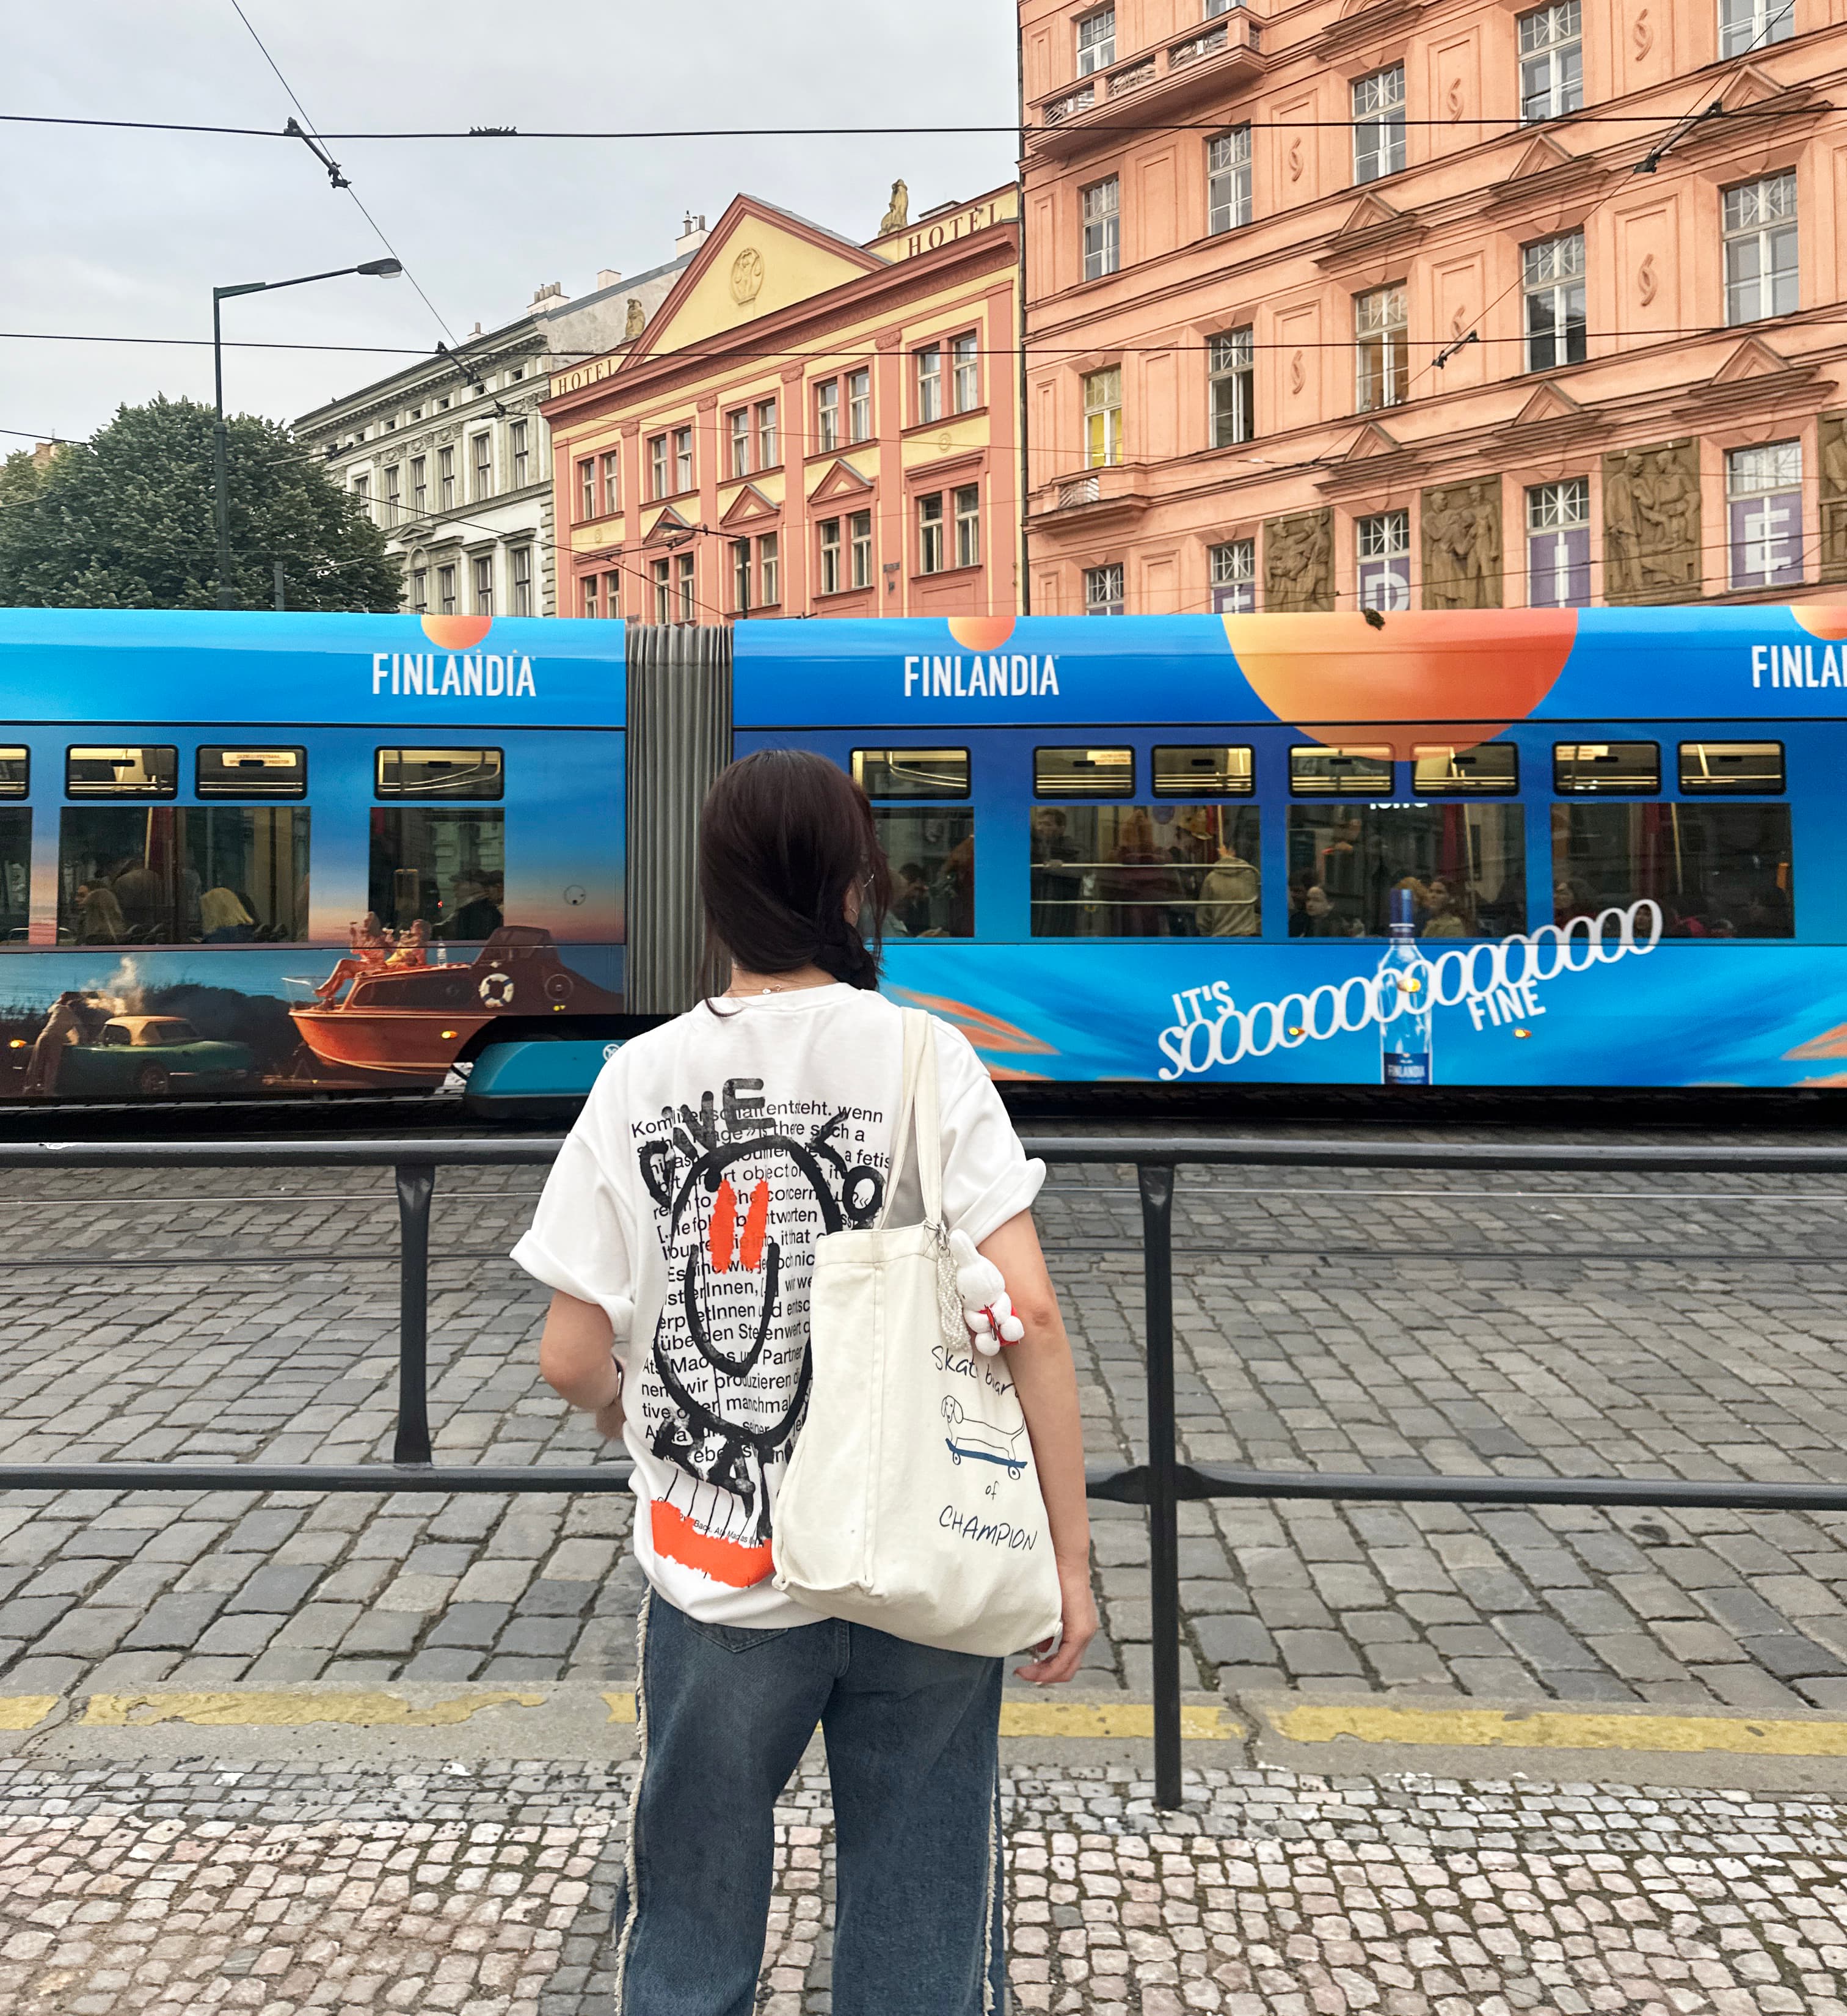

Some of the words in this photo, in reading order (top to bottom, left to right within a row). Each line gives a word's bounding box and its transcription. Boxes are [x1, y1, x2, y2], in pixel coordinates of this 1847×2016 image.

[908, 202, 1002, 257] HOTEL
[1744, 508, 1791, 573] E
[373, 652, 537, 696] FINLANDIA
[905, 655, 1059, 696] FINLANDIA
[1751, 645, 1847, 688] FINLA
[1172, 981, 1235, 1027] IT'S
[1466, 979, 1546, 1031] FINE
[838, 1106, 883, 1123] wenn
[811, 1123, 849, 1140] sch
[855, 1130, 865, 1142] a
[743, 1163, 789, 1183] object
[845, 1150, 852, 1163] a
[658, 1306, 756, 1332] erpetInnen
[763, 1346, 803, 1365] Partner
[931, 1346, 978, 1379] Skat
[642, 1403, 671, 1419] tive
[726, 1394, 792, 1414] manchmal
[985, 1480, 1000, 1500] of
[939, 1505, 1038, 1550] CHAMPION
